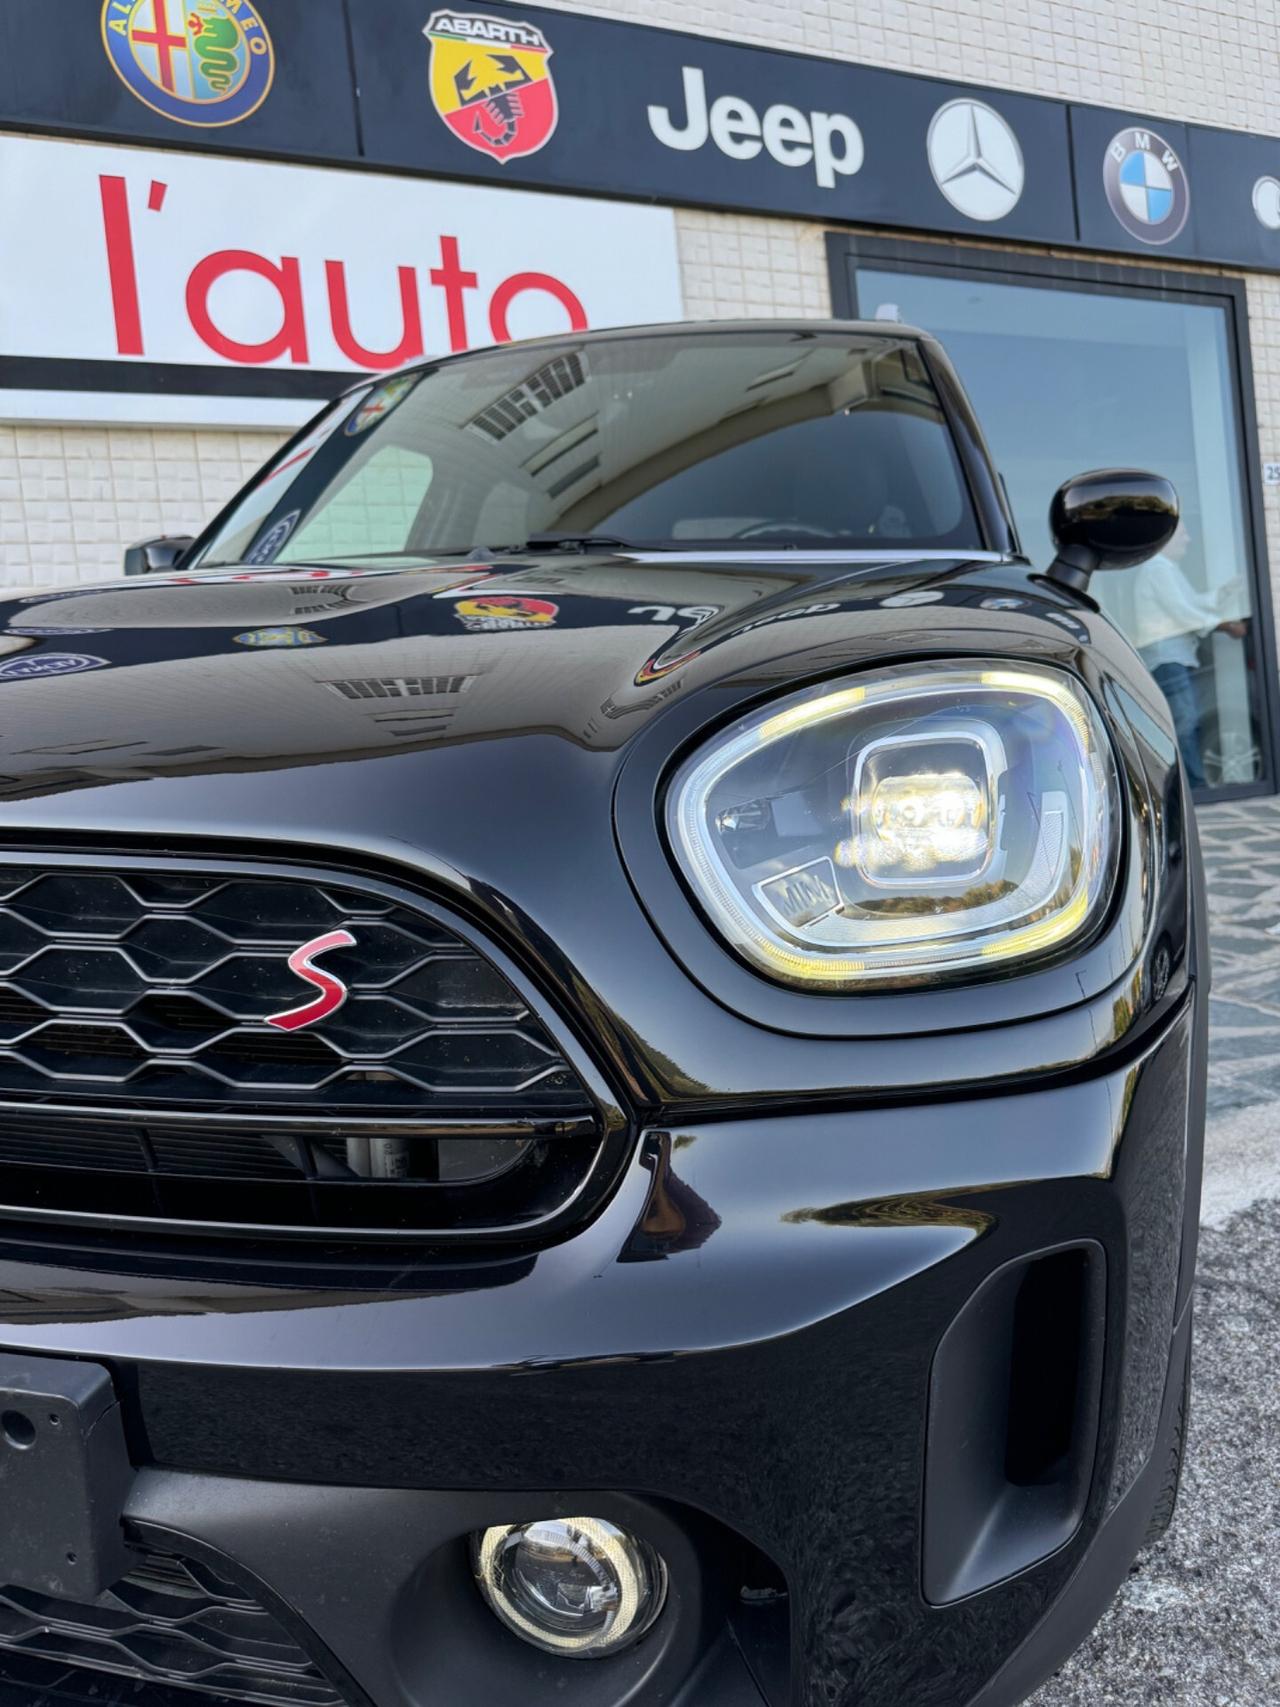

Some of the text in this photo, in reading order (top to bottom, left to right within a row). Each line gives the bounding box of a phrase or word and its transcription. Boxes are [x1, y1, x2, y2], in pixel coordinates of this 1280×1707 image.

[435, 18, 540, 46] ABARTH
[647, 66, 865, 189] Jeep
[1110, 132, 1179, 172] BMW
[99, 175, 588, 371] l'auto
[264, 929, 357, 1032] S
